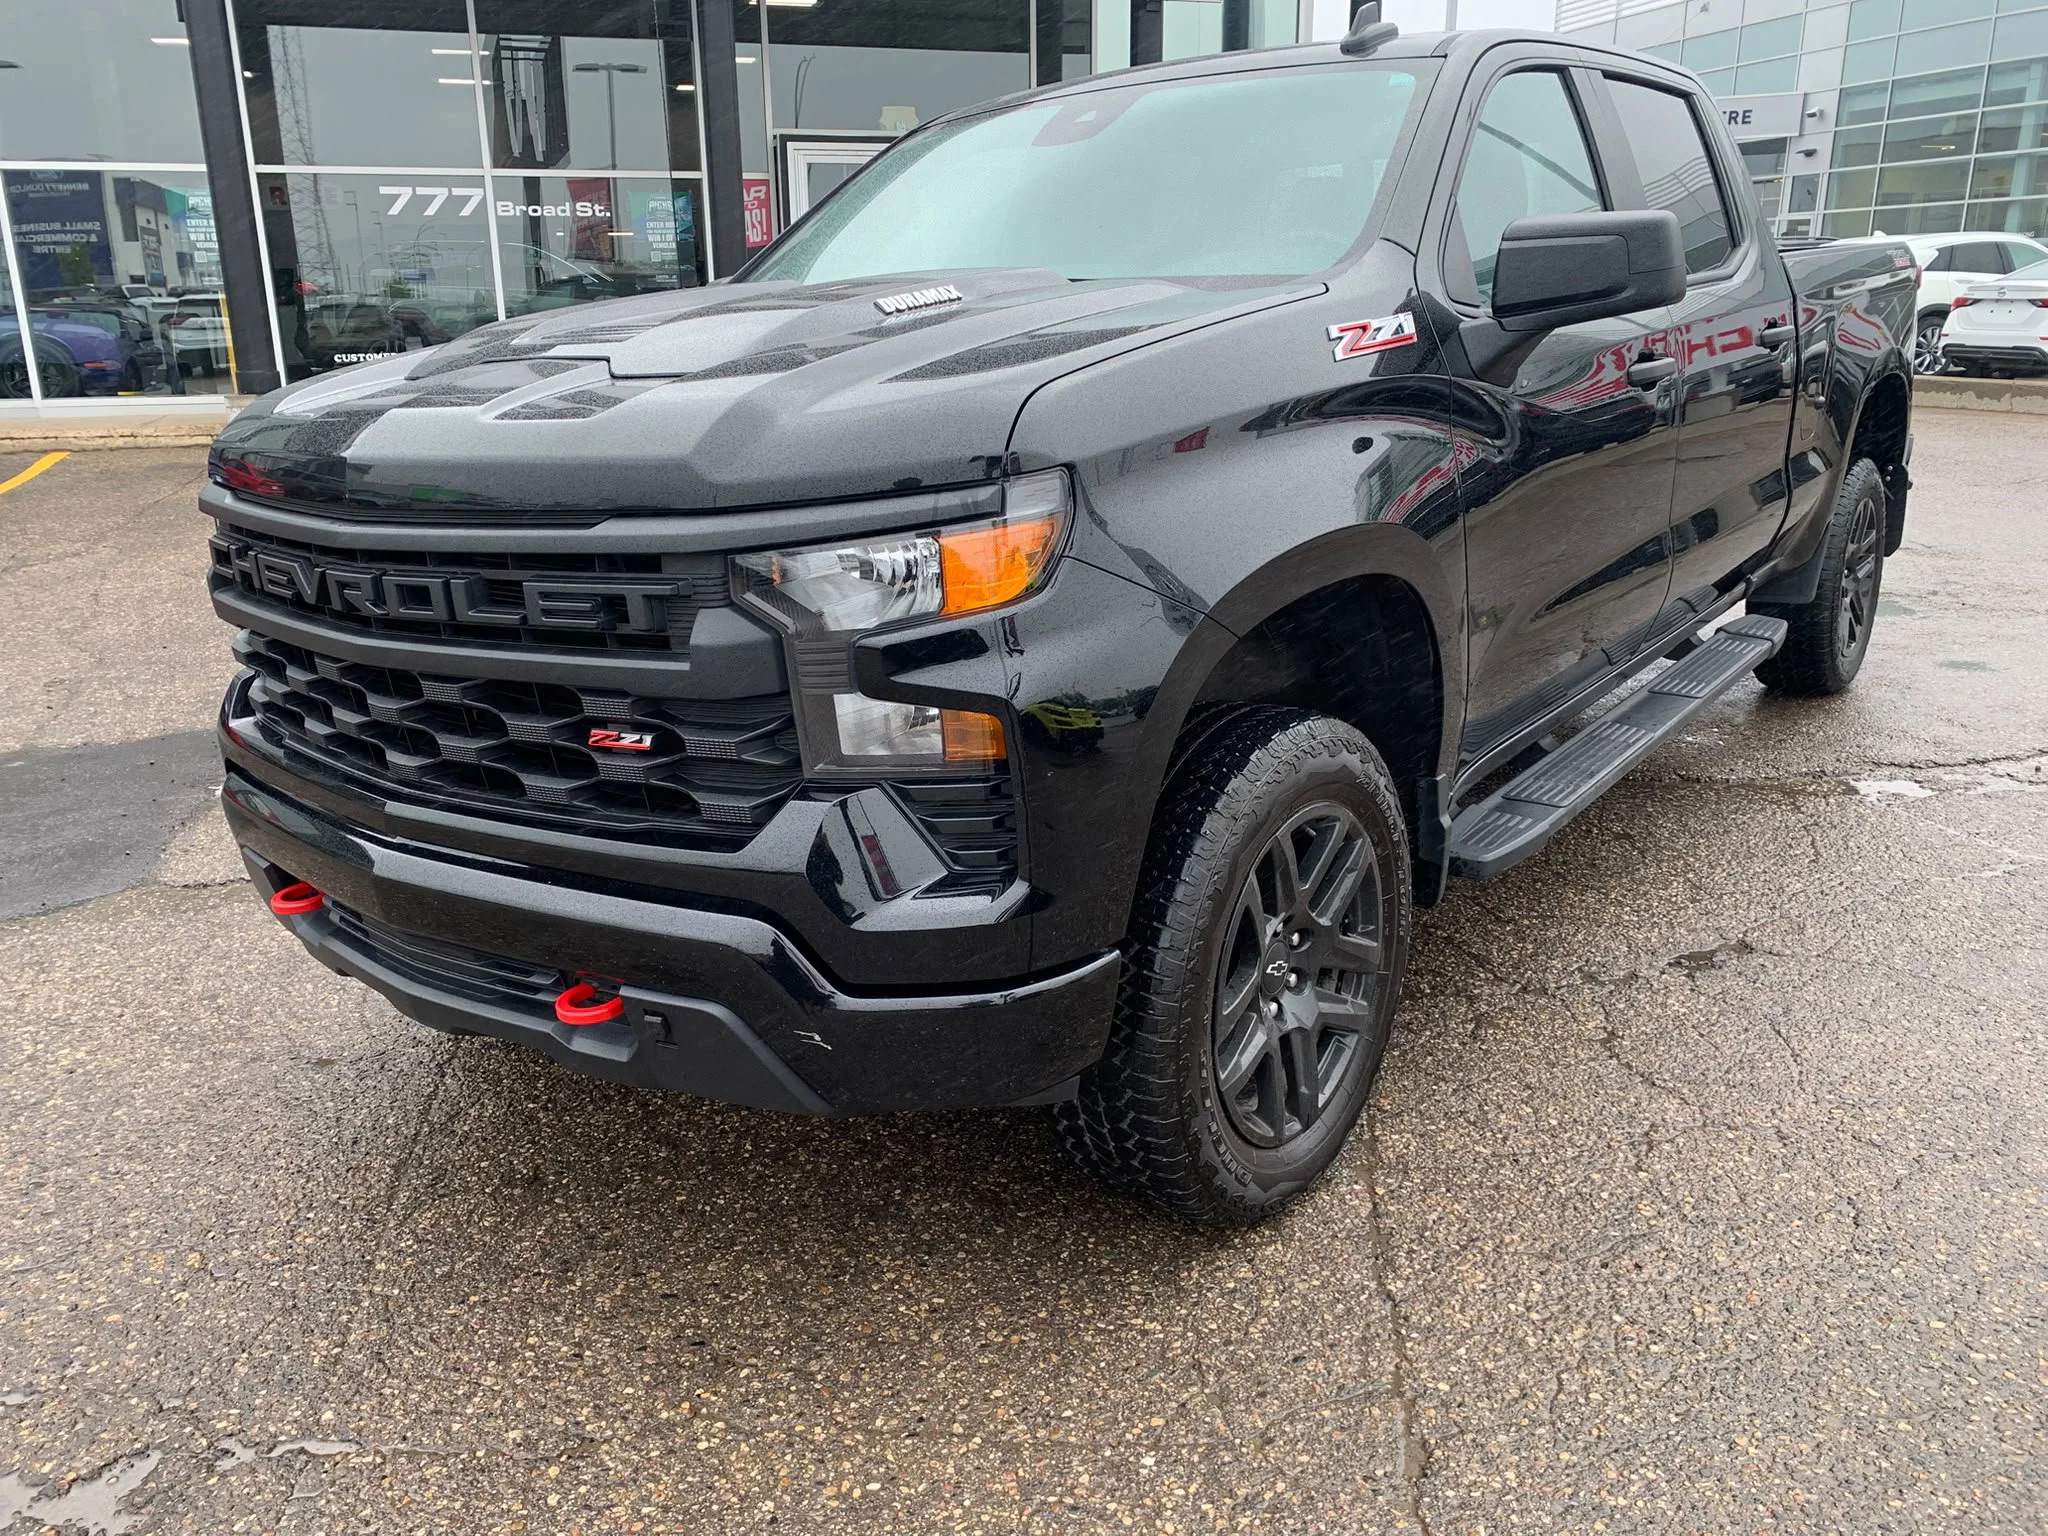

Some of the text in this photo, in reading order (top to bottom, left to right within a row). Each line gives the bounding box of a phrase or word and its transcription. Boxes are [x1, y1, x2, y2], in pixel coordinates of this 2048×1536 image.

[1722, 109, 1753, 125] RE
[379, 186, 611, 217] 777 Broad St.
[874, 284, 963, 316] DURAMAX
[1327, 311, 1418, 362] Z71
[334, 351, 399, 363] CUSTOM
[208, 534, 691, 633] CHEVROLET
[587, 729, 654, 751] Z71
